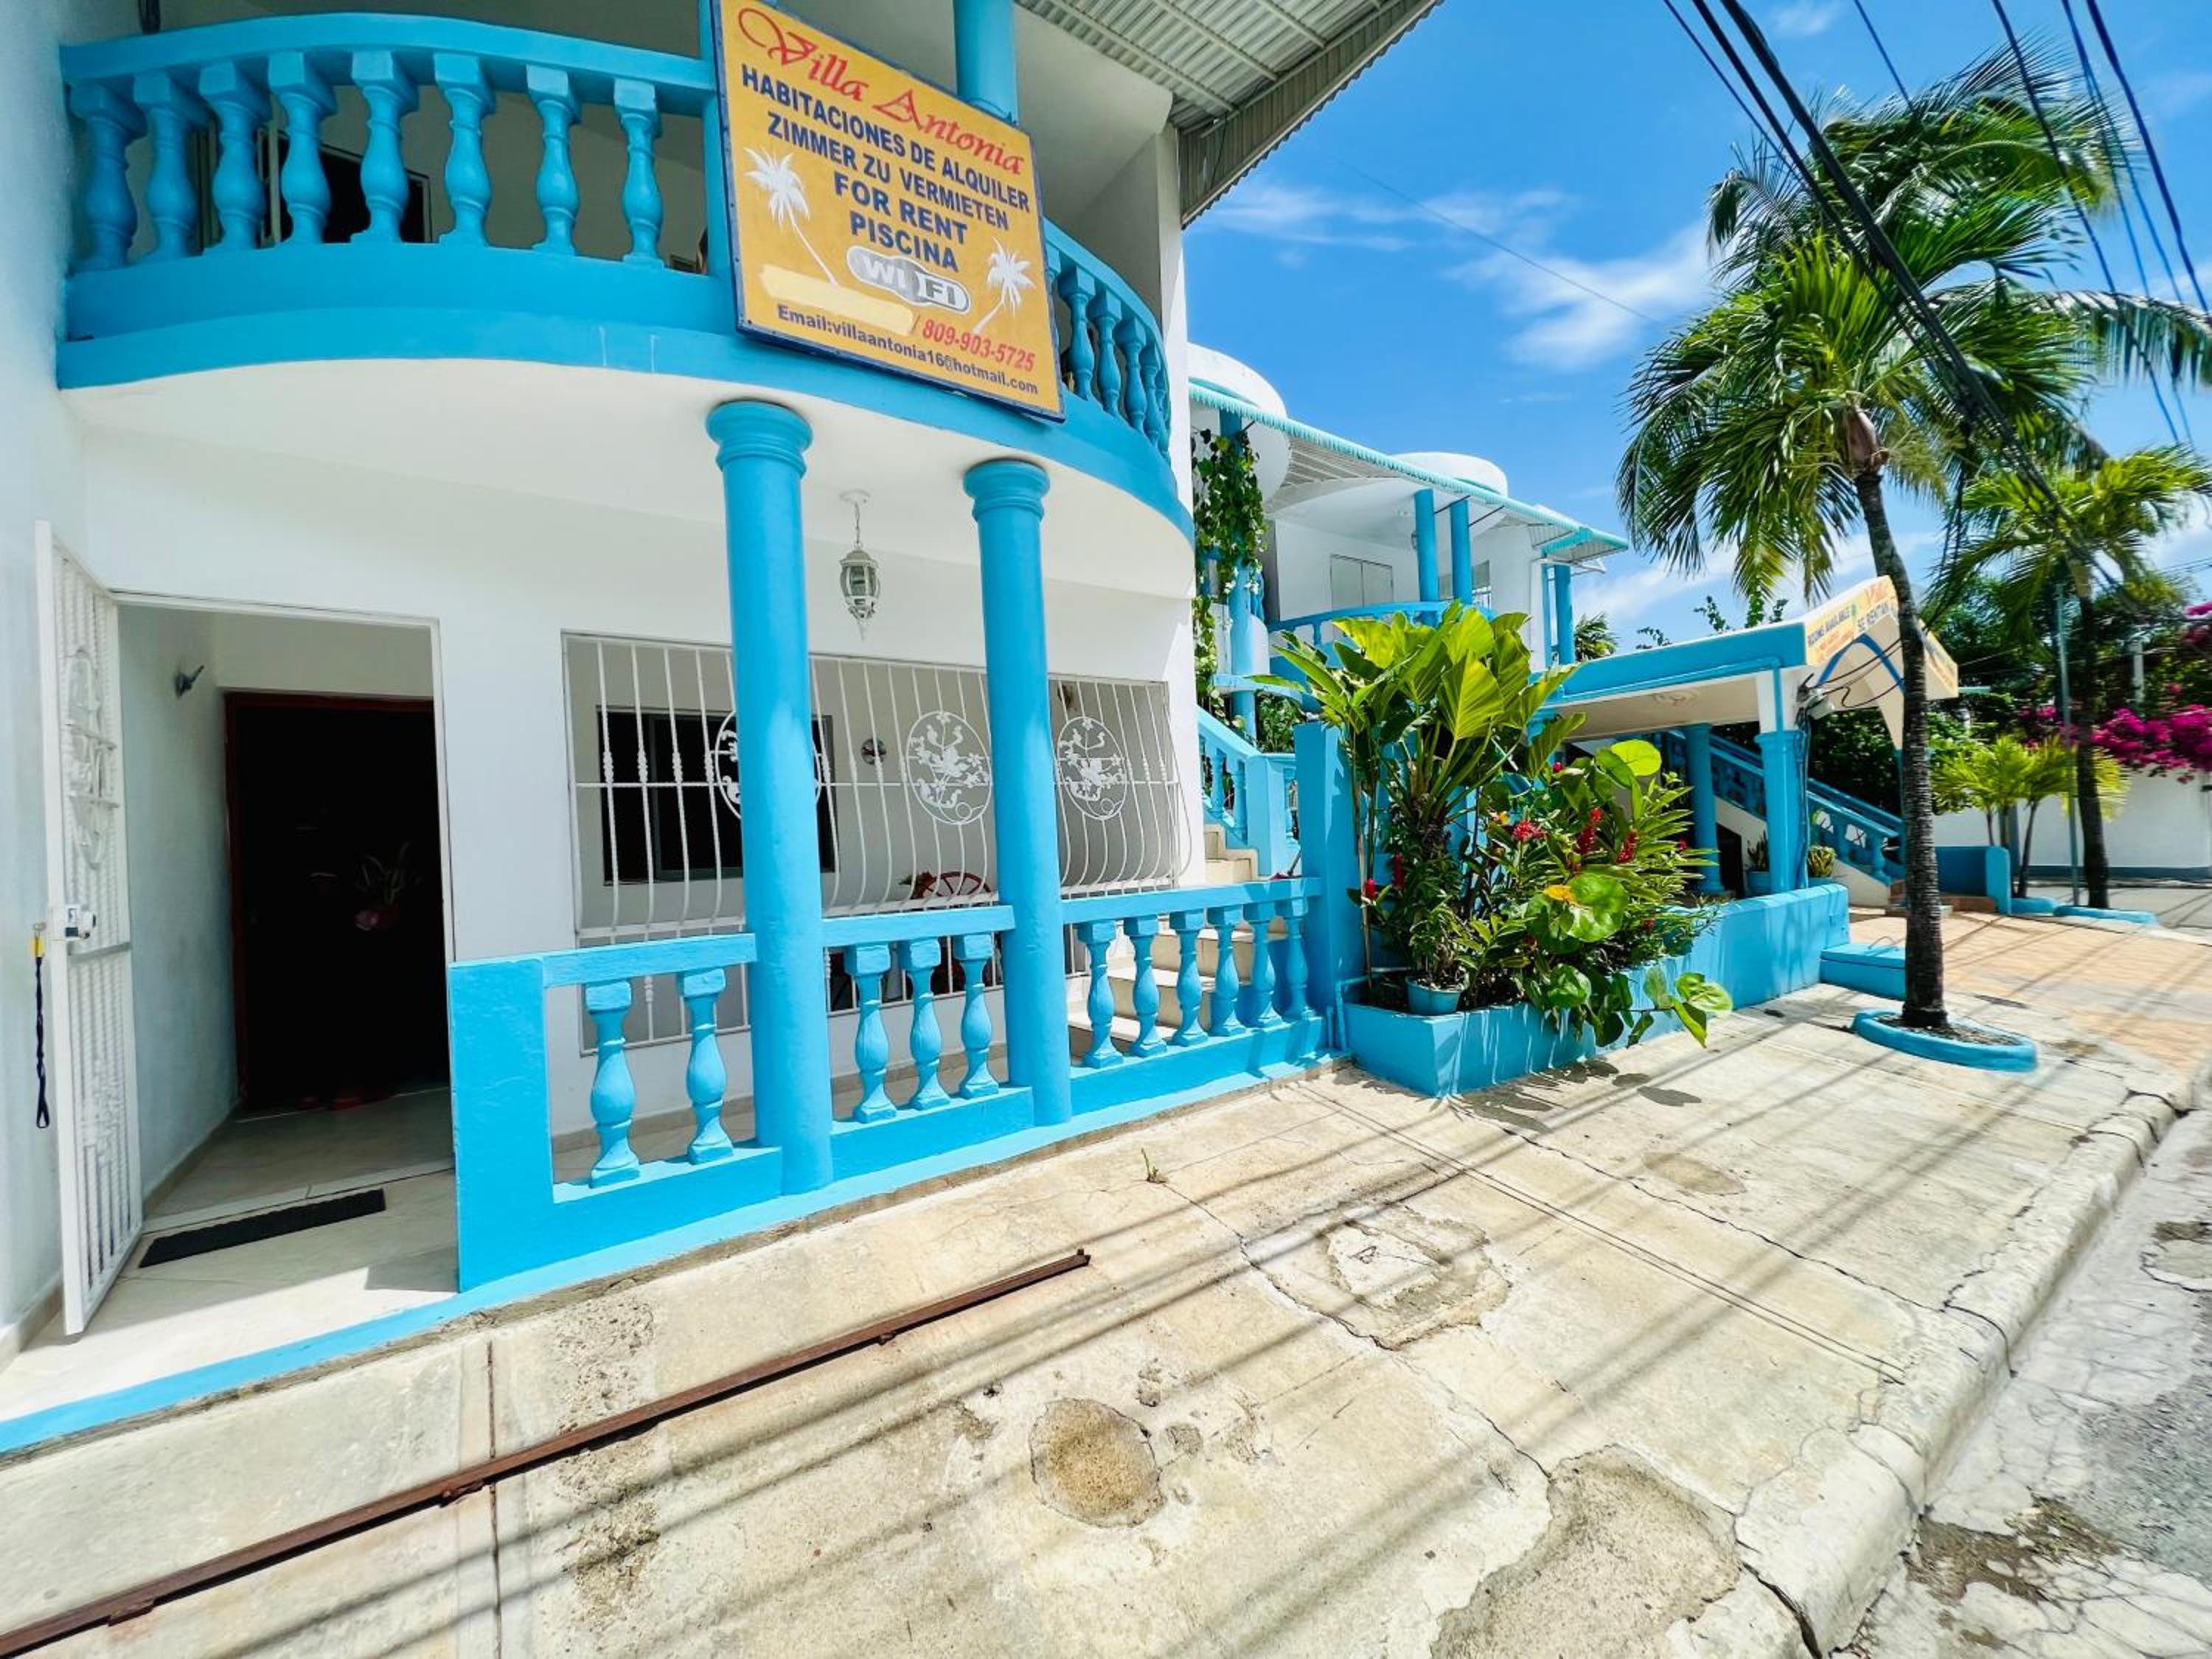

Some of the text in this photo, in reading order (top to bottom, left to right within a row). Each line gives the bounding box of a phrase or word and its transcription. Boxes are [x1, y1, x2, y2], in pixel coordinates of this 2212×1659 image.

[738, 7, 1025, 175] Villa Antonia
[741, 63, 1030, 213] HABITACIONES DE ALQUILER
[768, 111, 1009, 230] ZIMMER ZU VERMIETEN
[833, 171, 967, 245] FOR RENT
[850, 210, 959, 272] PISCINA
[922, 319, 1036, 372] 809-903-5725
